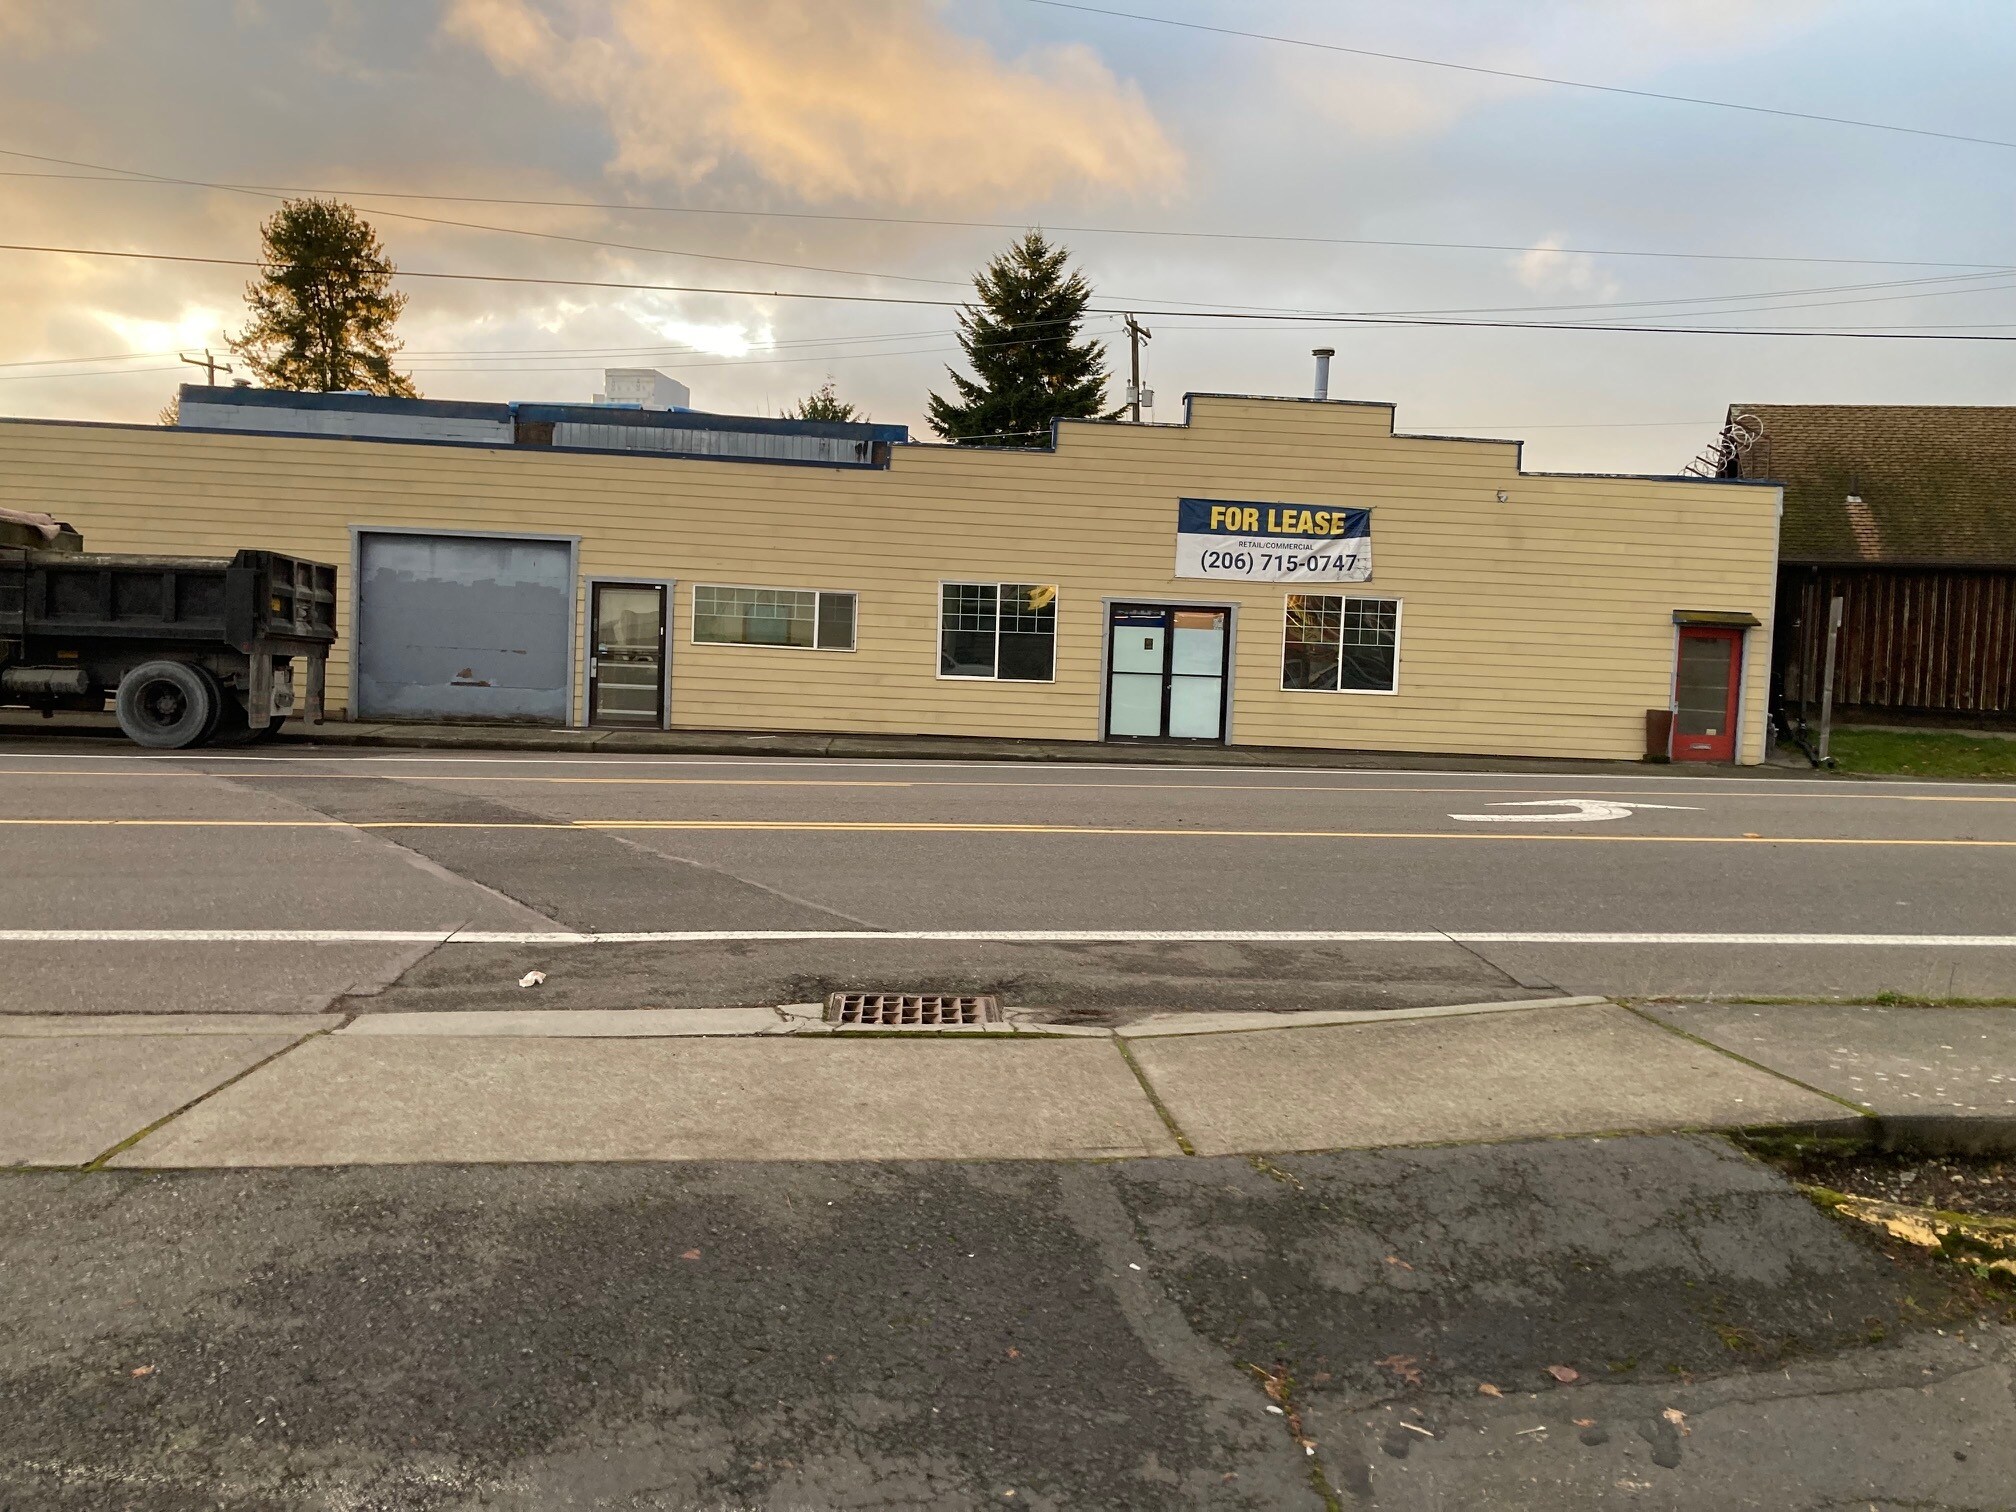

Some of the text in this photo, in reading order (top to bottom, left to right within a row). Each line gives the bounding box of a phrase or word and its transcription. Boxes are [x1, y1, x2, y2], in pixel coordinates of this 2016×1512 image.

[1210, 506, 1346, 535] FOR LEASE
[1238, 540, 1314, 551] RETAIL/COMMERCIAL
[1201, 550, 1357, 574] (206) 715-0747
